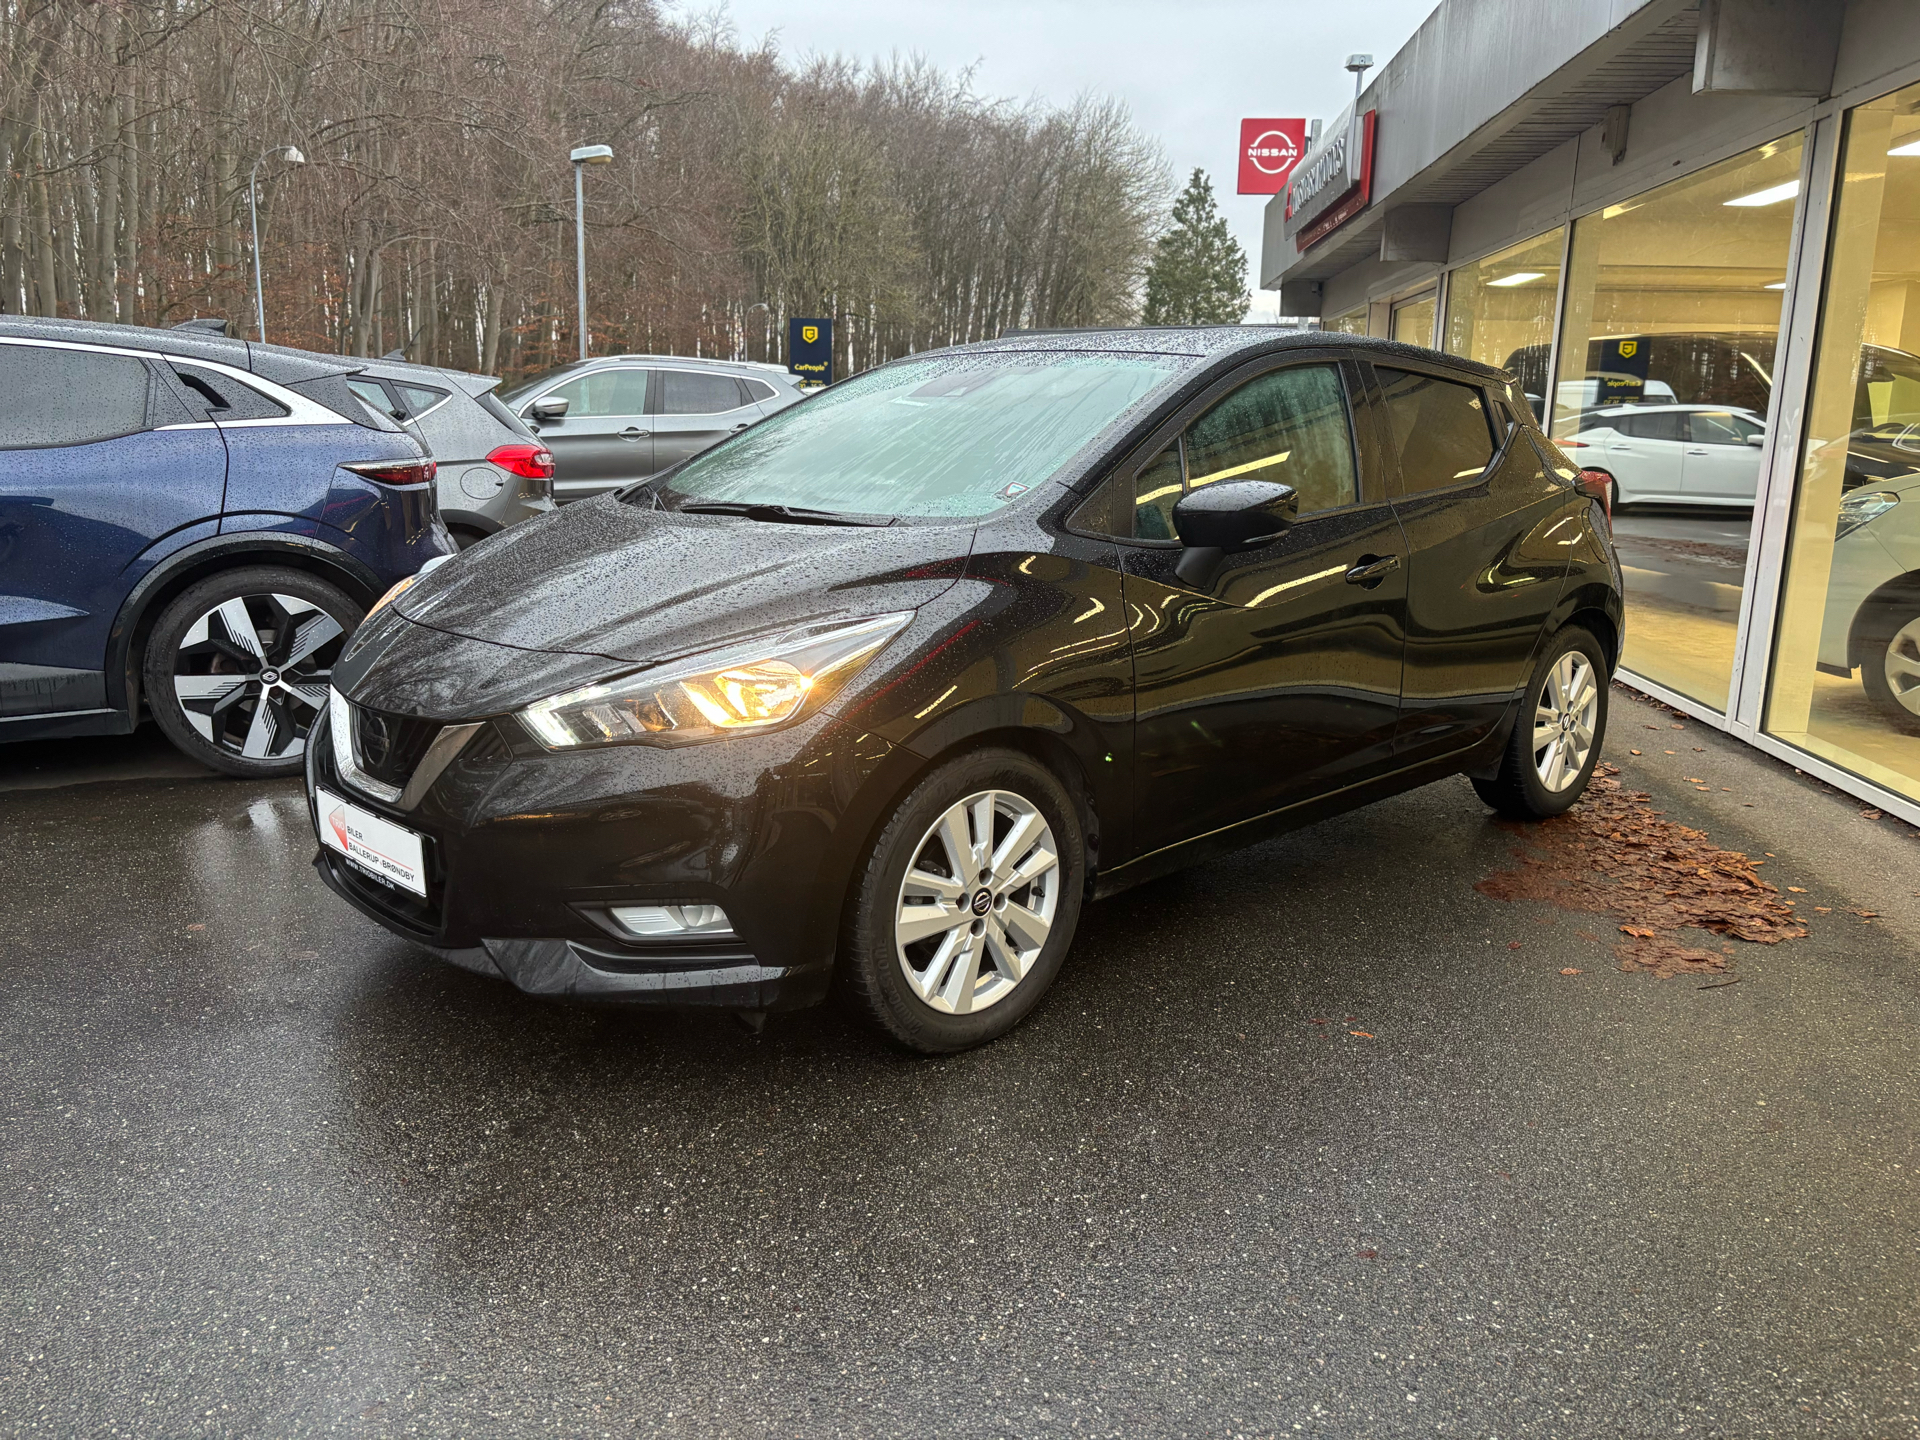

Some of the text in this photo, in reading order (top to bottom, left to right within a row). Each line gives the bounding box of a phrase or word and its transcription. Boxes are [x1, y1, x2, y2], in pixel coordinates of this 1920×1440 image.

[794, 364, 825, 372] CarPeople
[332, 817, 345, 830] TRIO
[347, 826, 363, 841] BILER
